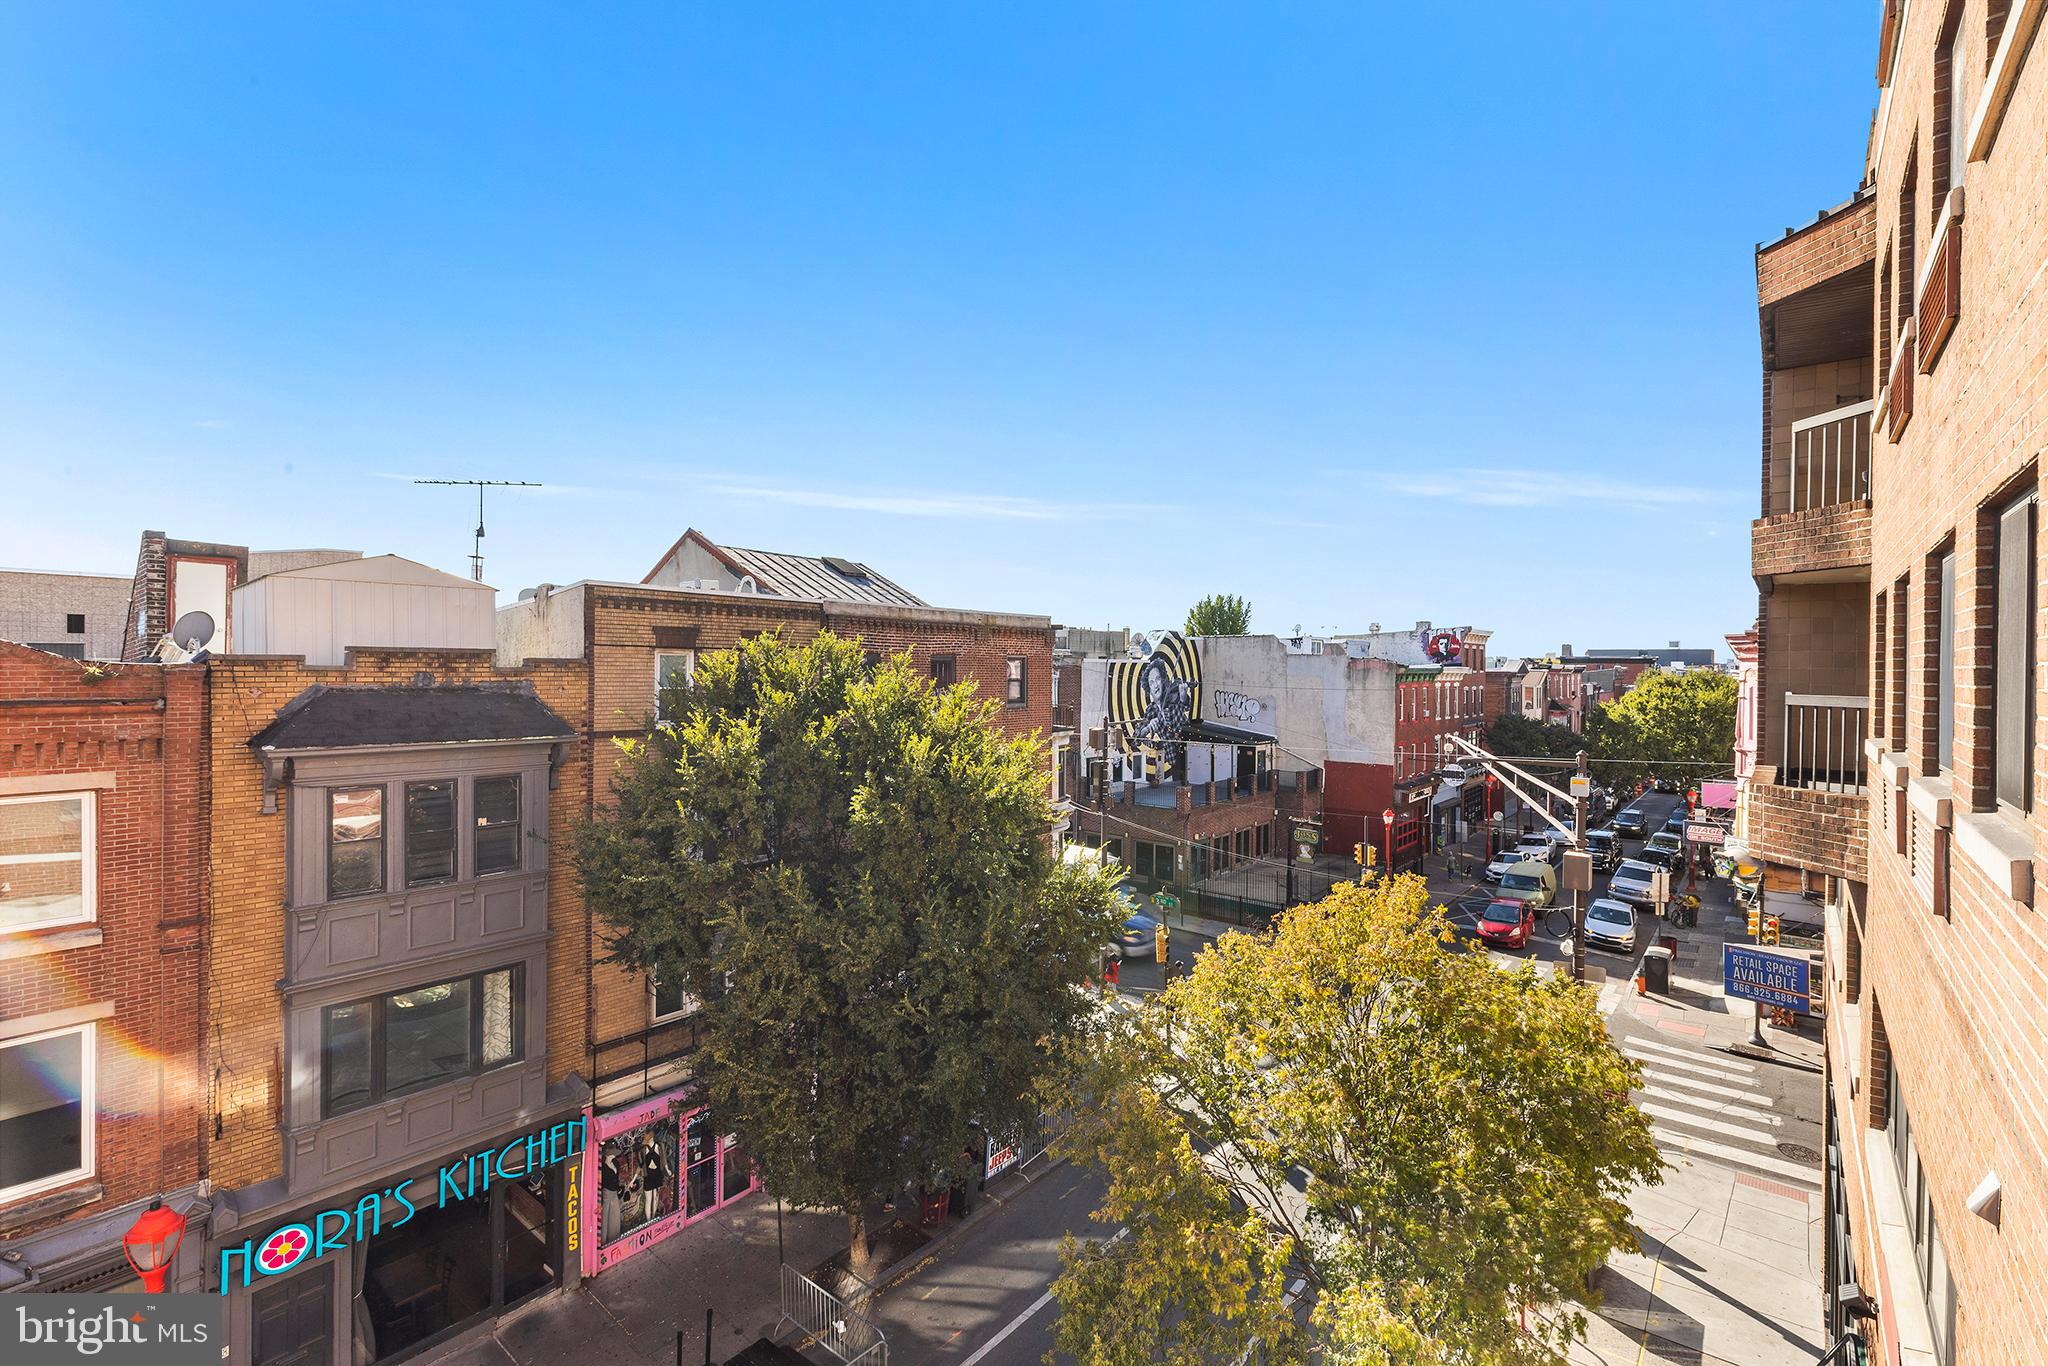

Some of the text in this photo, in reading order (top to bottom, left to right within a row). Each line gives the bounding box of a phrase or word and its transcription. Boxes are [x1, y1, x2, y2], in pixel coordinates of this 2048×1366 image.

[1687, 825, 1723, 835] IMAGE
[1699, 836, 1725, 844] SOUTH
[1733, 955, 1798, 978] RETAIL SPACE
[1733, 967, 1798, 993] AVAILABLE
[1733, 983, 1798, 1005] 866.925.6884
[638, 1108, 660, 1124] JADE
[989, 1147, 1012, 1170] JEEPS
[220, 1116, 587, 1297] NORA'S KITCHEN
[568, 1165, 579, 1251] TACOS
[610, 1229, 653, 1262] FASHION
